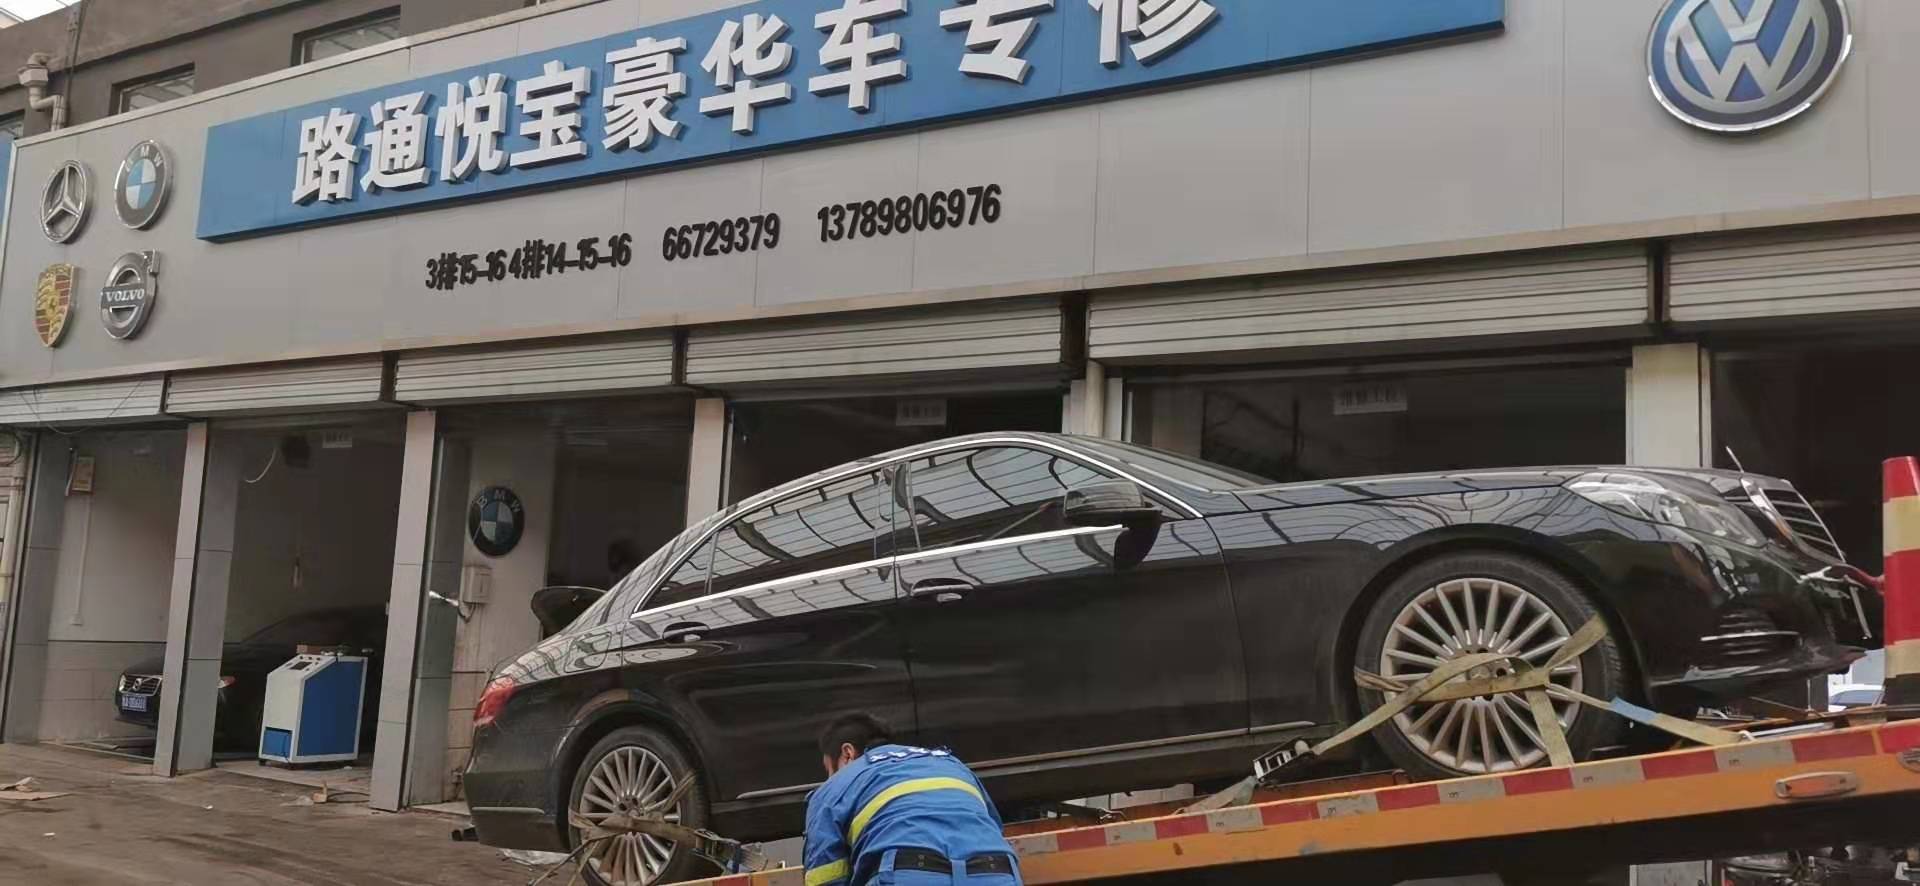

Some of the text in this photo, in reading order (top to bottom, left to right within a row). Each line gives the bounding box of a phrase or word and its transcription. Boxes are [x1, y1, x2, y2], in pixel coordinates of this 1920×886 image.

[662, 213, 780, 262] 66729379
[817, 184, 1001, 242] 13789806976
[105, 288, 145, 302] VOLVO
